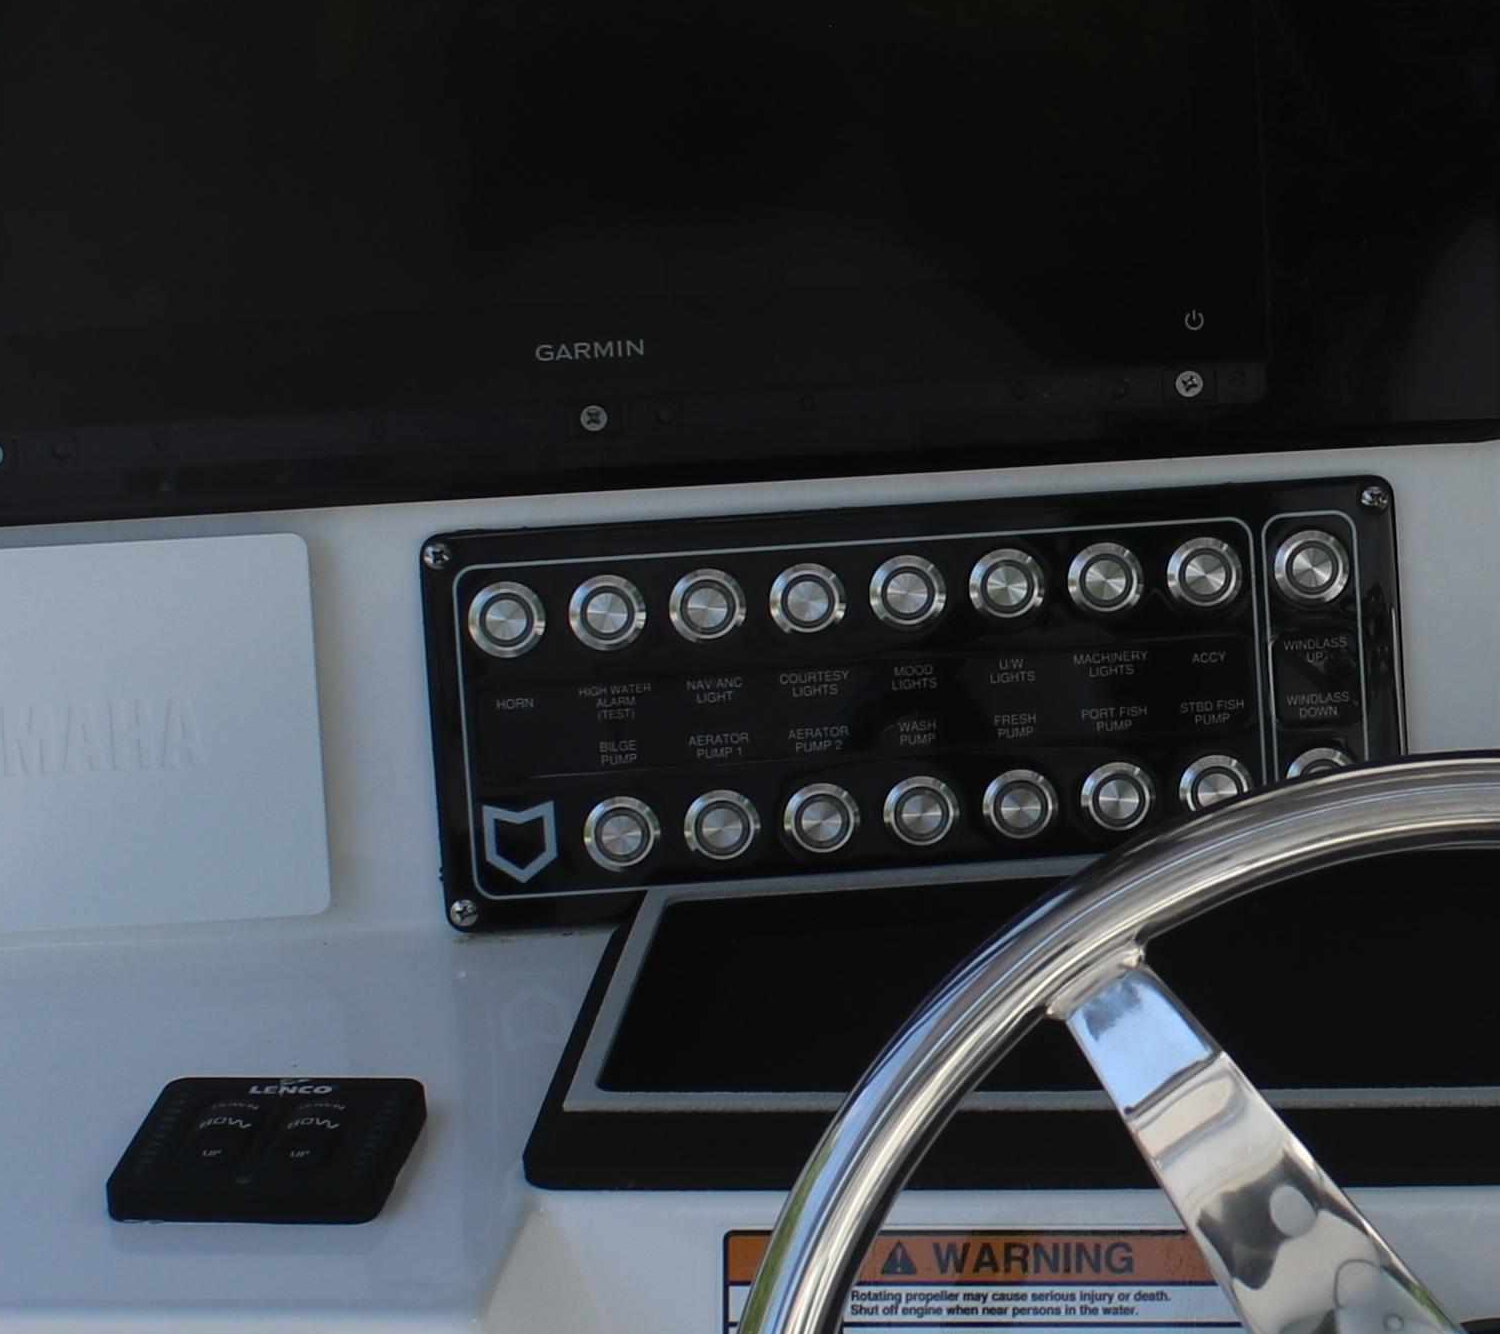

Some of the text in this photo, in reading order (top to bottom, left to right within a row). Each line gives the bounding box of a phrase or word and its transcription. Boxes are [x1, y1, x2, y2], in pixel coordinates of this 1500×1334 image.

[535, 339, 645, 362] GARMIN
[1284, 636, 1348, 651] WINDLASS
[1073, 650, 1148, 666] MACHINERY
[1192, 652, 1226, 664] ACCY
[1306, 651, 1324, 663] UP
[894, 664, 933, 677] MOOD
[990, 670, 1036, 684] LIGHTS
[1089, 665, 1134, 677] LIGHTS
[779, 670, 850, 685] COURTESY
[892, 676, 937, 691] LIGHTS
[579, 683, 651, 697] HIGH WATER
[792, 684, 838, 697] LIGHTS
[496, 698, 534, 710] HORN
[596, 696, 636, 708] ALARM
[696, 691, 733, 704] LIGHT
[1286, 692, 1350, 706] WINDLASS
[1081, 705, 1148, 720] PORT FISH
[1180, 698, 1244, 714] STBD FISH
[1300, 706, 1337, 718] DOWN
[994, 713, 1036, 726] FRESH
[1195, 713, 1230, 725] PUMP
[788, 726, 849, 739] AERATOR
[898, 720, 936, 733] WASH
[1097, 720, 1133, 732] PUMP
[900, 733, 936, 746] PUMP
[998, 727, 1034, 739] PUMP
[600, 740, 637, 753] BILGE
[689, 733, 749, 747] AERATOR
[795, 740, 842, 753] PUMP 2
[601, 753, 637, 765] PUMP
[696, 747, 733, 760] PUMP
[249, 1085, 333, 1095] LENCO
[932, 1241, 1135, 1275] WARNING
[850, 1290, 1171, 1305] Rotating propeller may cause serious injury or death.
[850, 1305, 1139, 1318] Shut off engine when near persons in the water.
